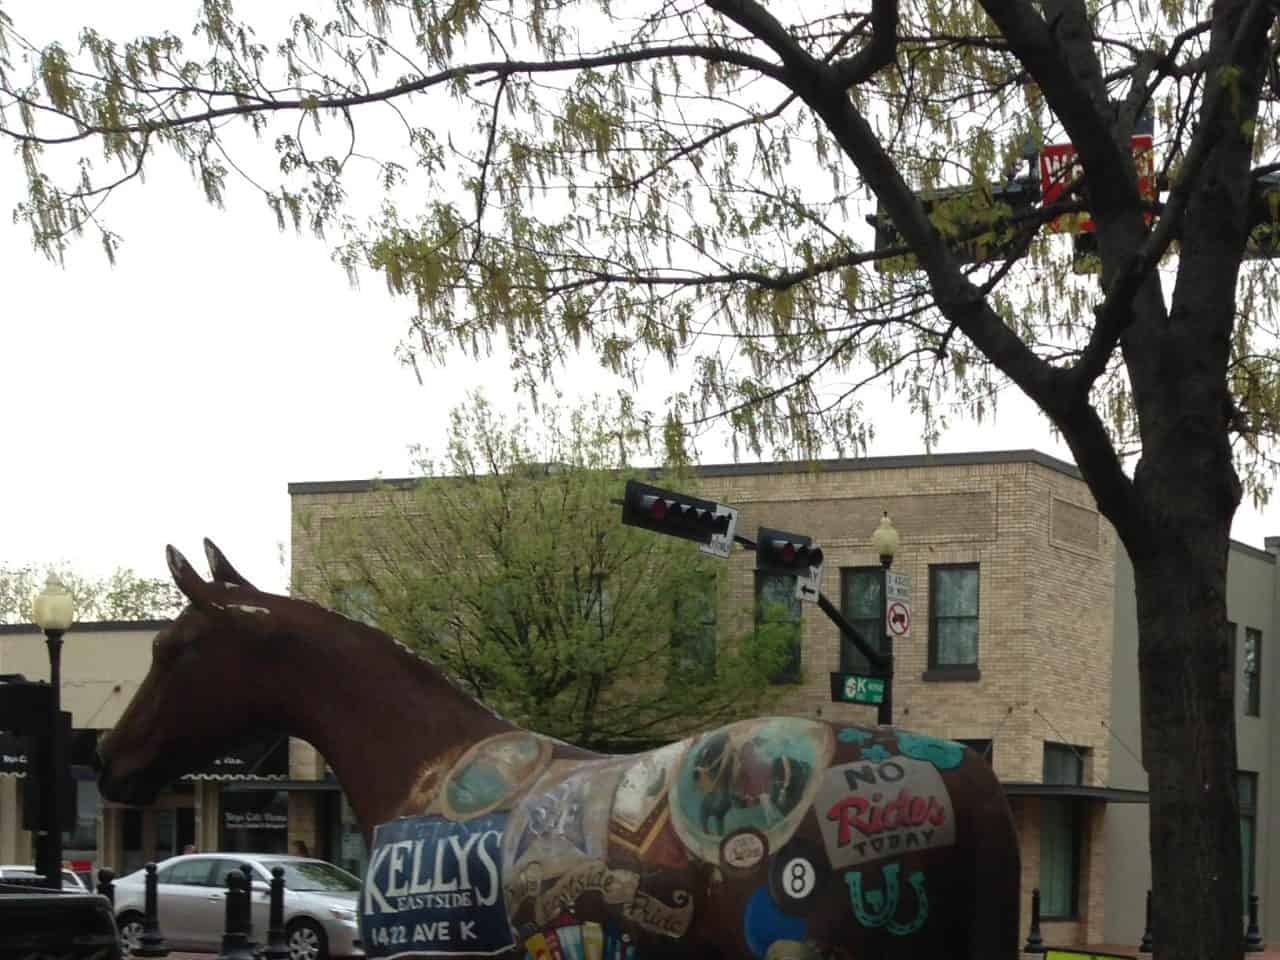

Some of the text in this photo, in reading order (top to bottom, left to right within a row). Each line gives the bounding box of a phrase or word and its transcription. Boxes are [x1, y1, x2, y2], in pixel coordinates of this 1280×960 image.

[843, 761, 905, 790] NO
[826, 791, 946, 847] Rides
[854, 828, 936, 857] TODAY
[364, 829, 505, 915] KELLYS
[790, 863, 807, 895] 8
[397, 891, 473, 912] EASTSIDE
[371, 919, 478, 946] 1422 AVE K
